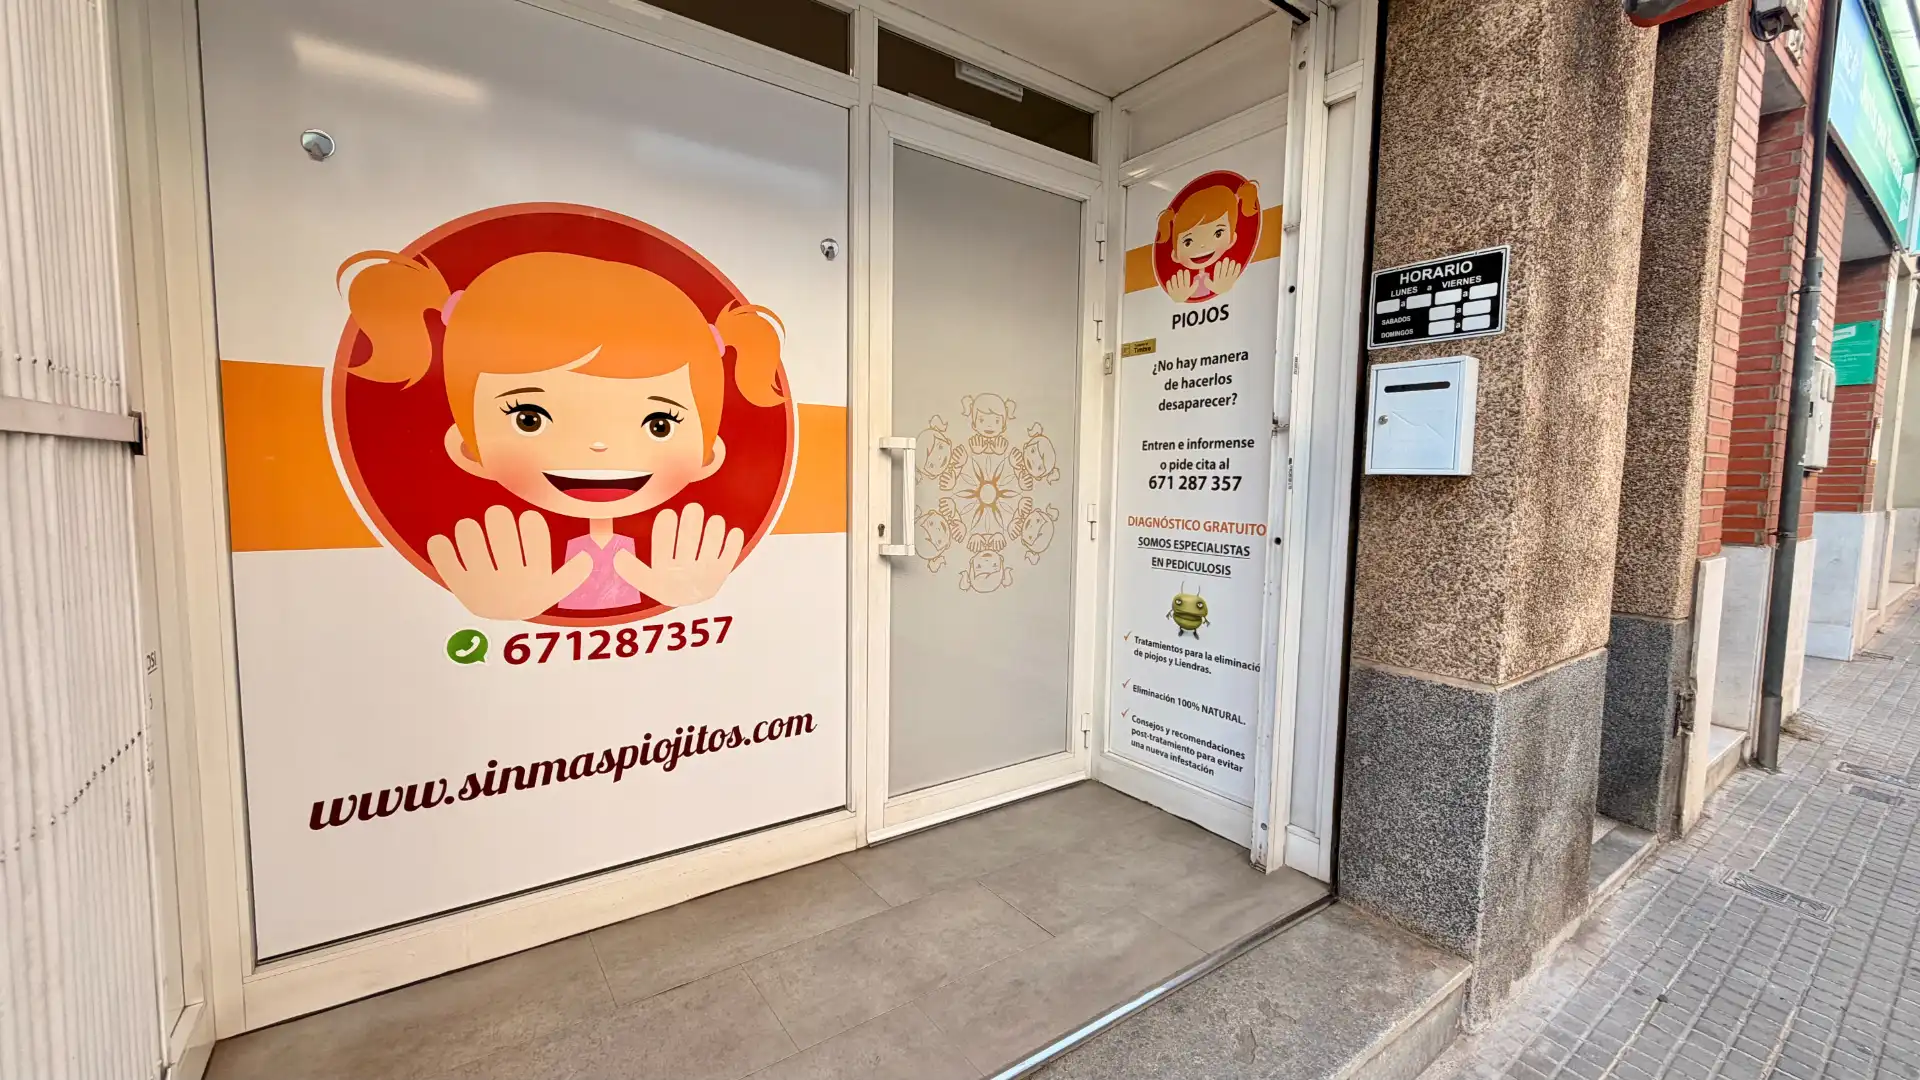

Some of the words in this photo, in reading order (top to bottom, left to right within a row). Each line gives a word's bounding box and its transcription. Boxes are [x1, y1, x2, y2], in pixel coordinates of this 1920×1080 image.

[1400, 261, 1473, 285] HORARIO
[1390, 286, 1418, 298] LUNES
[1442, 275, 1482, 289] VIERNES
[1172, 304, 1229, 329] PIOJOS
[1381, 316, 1411, 326] SABADOS
[1381, 329, 1414, 339] DOMINGOS
[1152, 359, 1173, 376] ¿No
[1176, 354, 1197, 373] hay
[1200, 350, 1249, 367] manera
[1164, 377, 1178, 391] de
[1181, 372, 1232, 389] hacerlos
[1158, 393, 1238, 413] desaparecer?
[1142, 440, 1175, 451] Entren
[1178, 441, 1184, 450] e
[1187, 437, 1255, 450] informense
[1160, 462, 1167, 470] o
[1169, 459, 1193, 472] pide
[1195, 459, 1216, 470] cita
[1219, 458, 1230, 470] al
[1148, 475, 1174, 489] 671
[1178, 475, 1207, 490] 287
[1211, 476, 1242, 491] 357
[1127, 515, 1200, 531] DIAGNÓSTICO
[1203, 520, 1267, 536] GRATUITO
[1138, 536, 1171, 549] SOMOS
[1173, 540, 1250, 557] ESPECIALISTAS
[1151, 556, 1164, 567] EN
[1166, 558, 1231, 576] PEDICULOSIS
[503, 616, 733, 665] 671287357
[1134, 636, 1183, 654] Tratamientos
[1184, 649, 1203, 660] para
[1204, 651, 1213, 662] la
[1214, 654, 1261, 673] eliminació
[1134, 648, 1143, 657] de
[1144, 650, 1167, 664] piojos
[1168, 657, 1174, 666] y
[1174, 657, 1212, 675] Liendras.
[1132, 684, 1175, 705] Eliminación
[1178, 697, 1200, 712] 100%
[1201, 704, 1246, 725] NATURAL.
[1131, 714, 1164, 733] Consejos
[1165, 727, 1170, 735] y
[1171, 729, 1246, 760] recomendaciones
[1131, 727, 1195, 756] post-tratamiento
[1197, 750, 1216, 763] para
[1217, 757, 1244, 773] evitar
[1131, 739, 1145, 750] una
[1146, 745, 1169, 760] nueva
[1170, 751, 1214, 776] infestación
[309, 712, 817, 830] www.sinmaspiojitos.com
